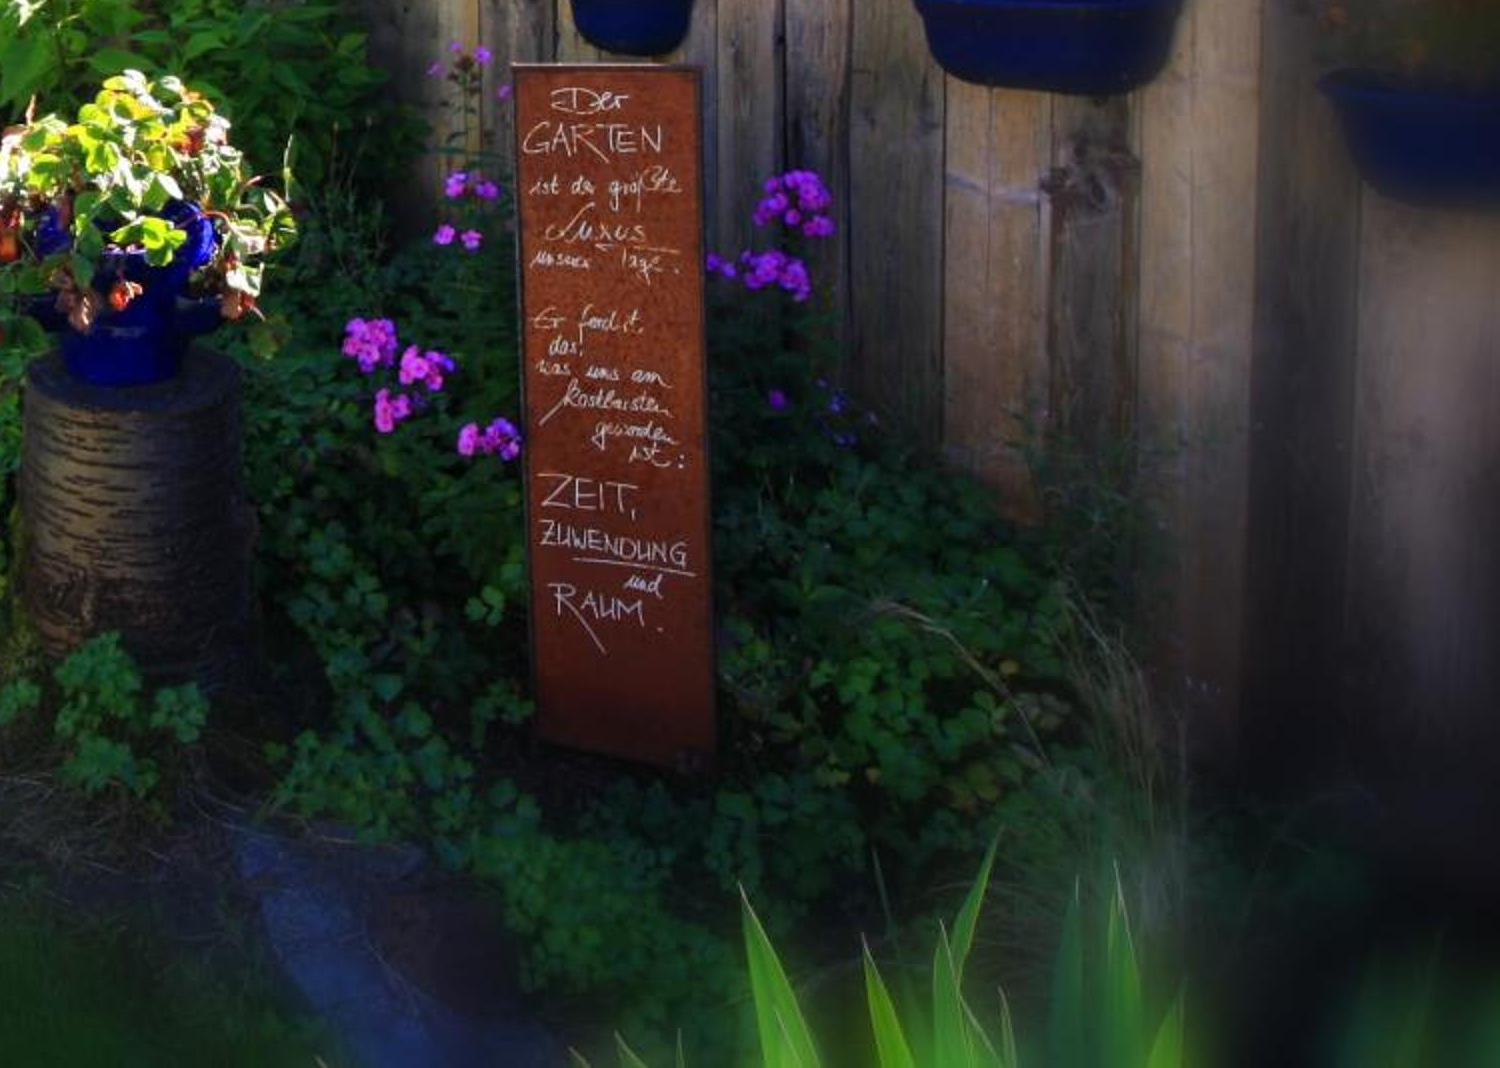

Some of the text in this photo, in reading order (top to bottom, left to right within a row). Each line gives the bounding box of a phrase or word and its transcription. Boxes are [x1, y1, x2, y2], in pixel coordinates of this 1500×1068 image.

[550, 87, 629, 114] Der
[522, 121, 662, 163] GARTEN
[529, 174, 560, 195] ist
[545, 202, 645, 243] Luxus
[532, 307, 565, 329] Er
[536, 359, 673, 389] was uns am
[536, 473, 639, 521] ZEIT,
[539, 519, 688, 568] ZUWENDUNG
[623, 574, 664, 600] und
